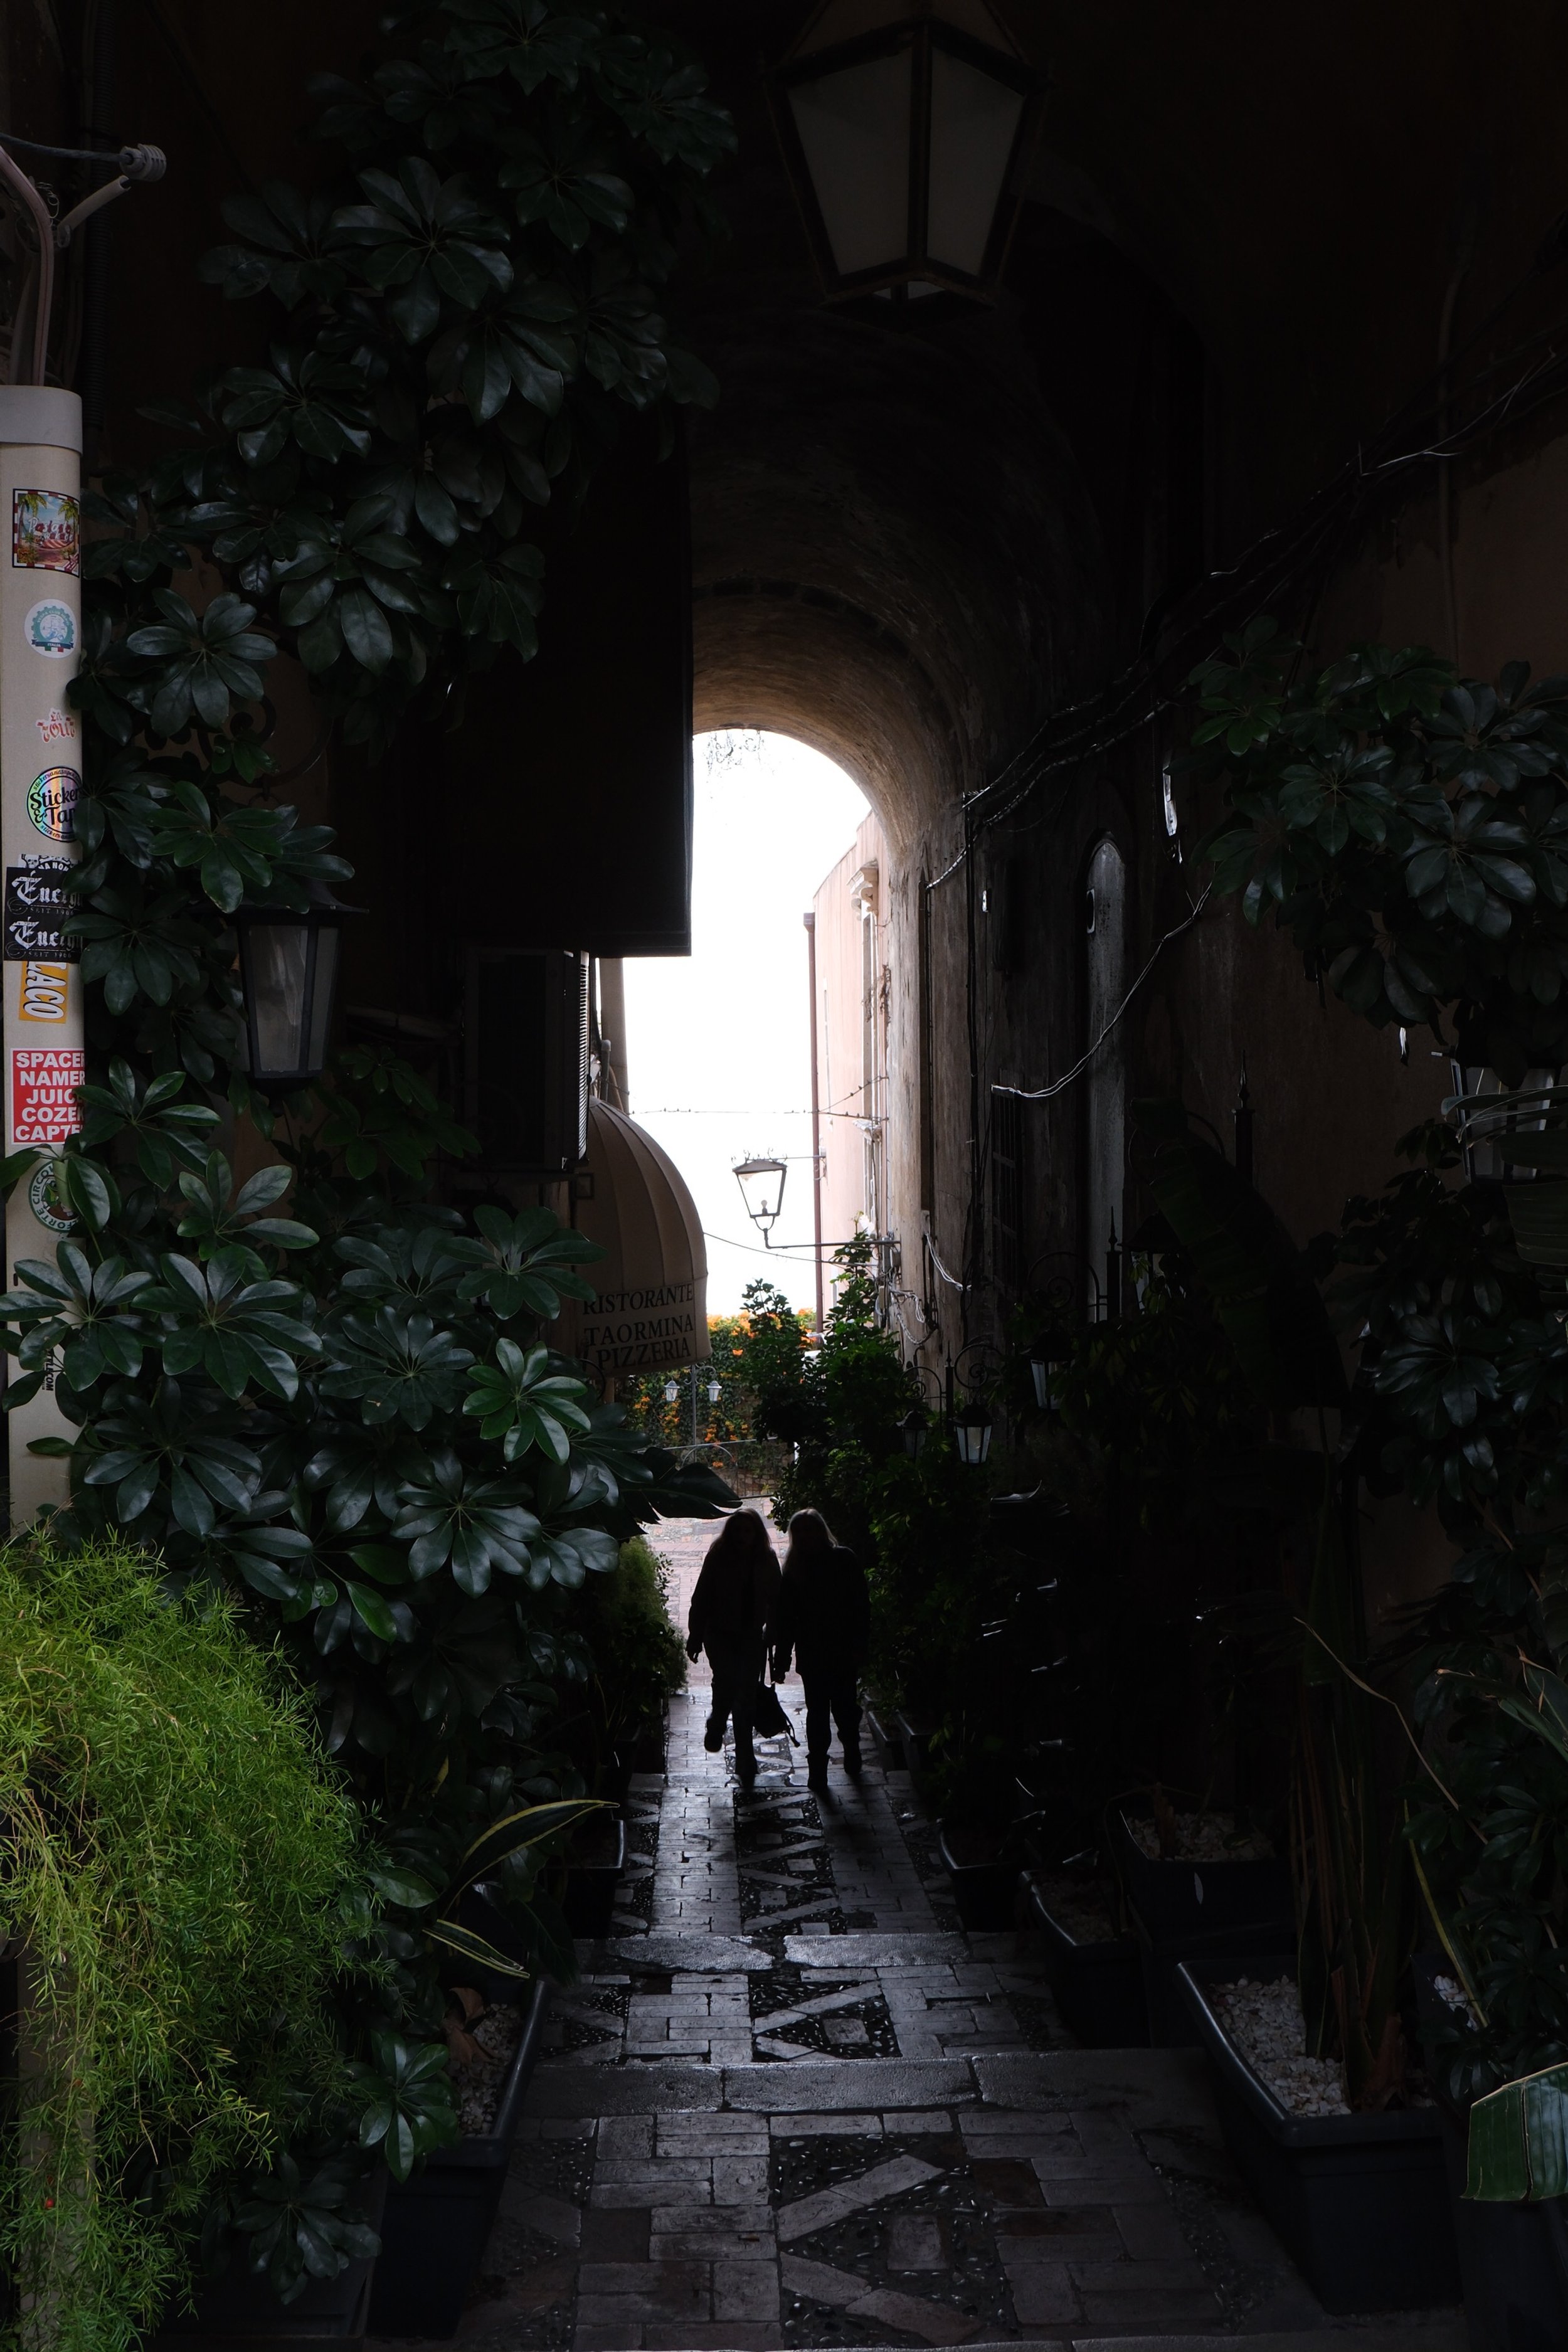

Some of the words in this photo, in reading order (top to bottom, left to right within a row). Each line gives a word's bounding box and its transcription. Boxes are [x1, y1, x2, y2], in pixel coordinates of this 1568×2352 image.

[30, 787, 82, 810] Sticker
[44, 805, 75, 826] Tap
[15, 1123, 83, 1141] CAPTE
[583, 1283, 694, 1315] RISTORANTE
[584, 1314, 694, 1347] TAORMINA
[596, 1337, 692, 1370] PIZZERIA
